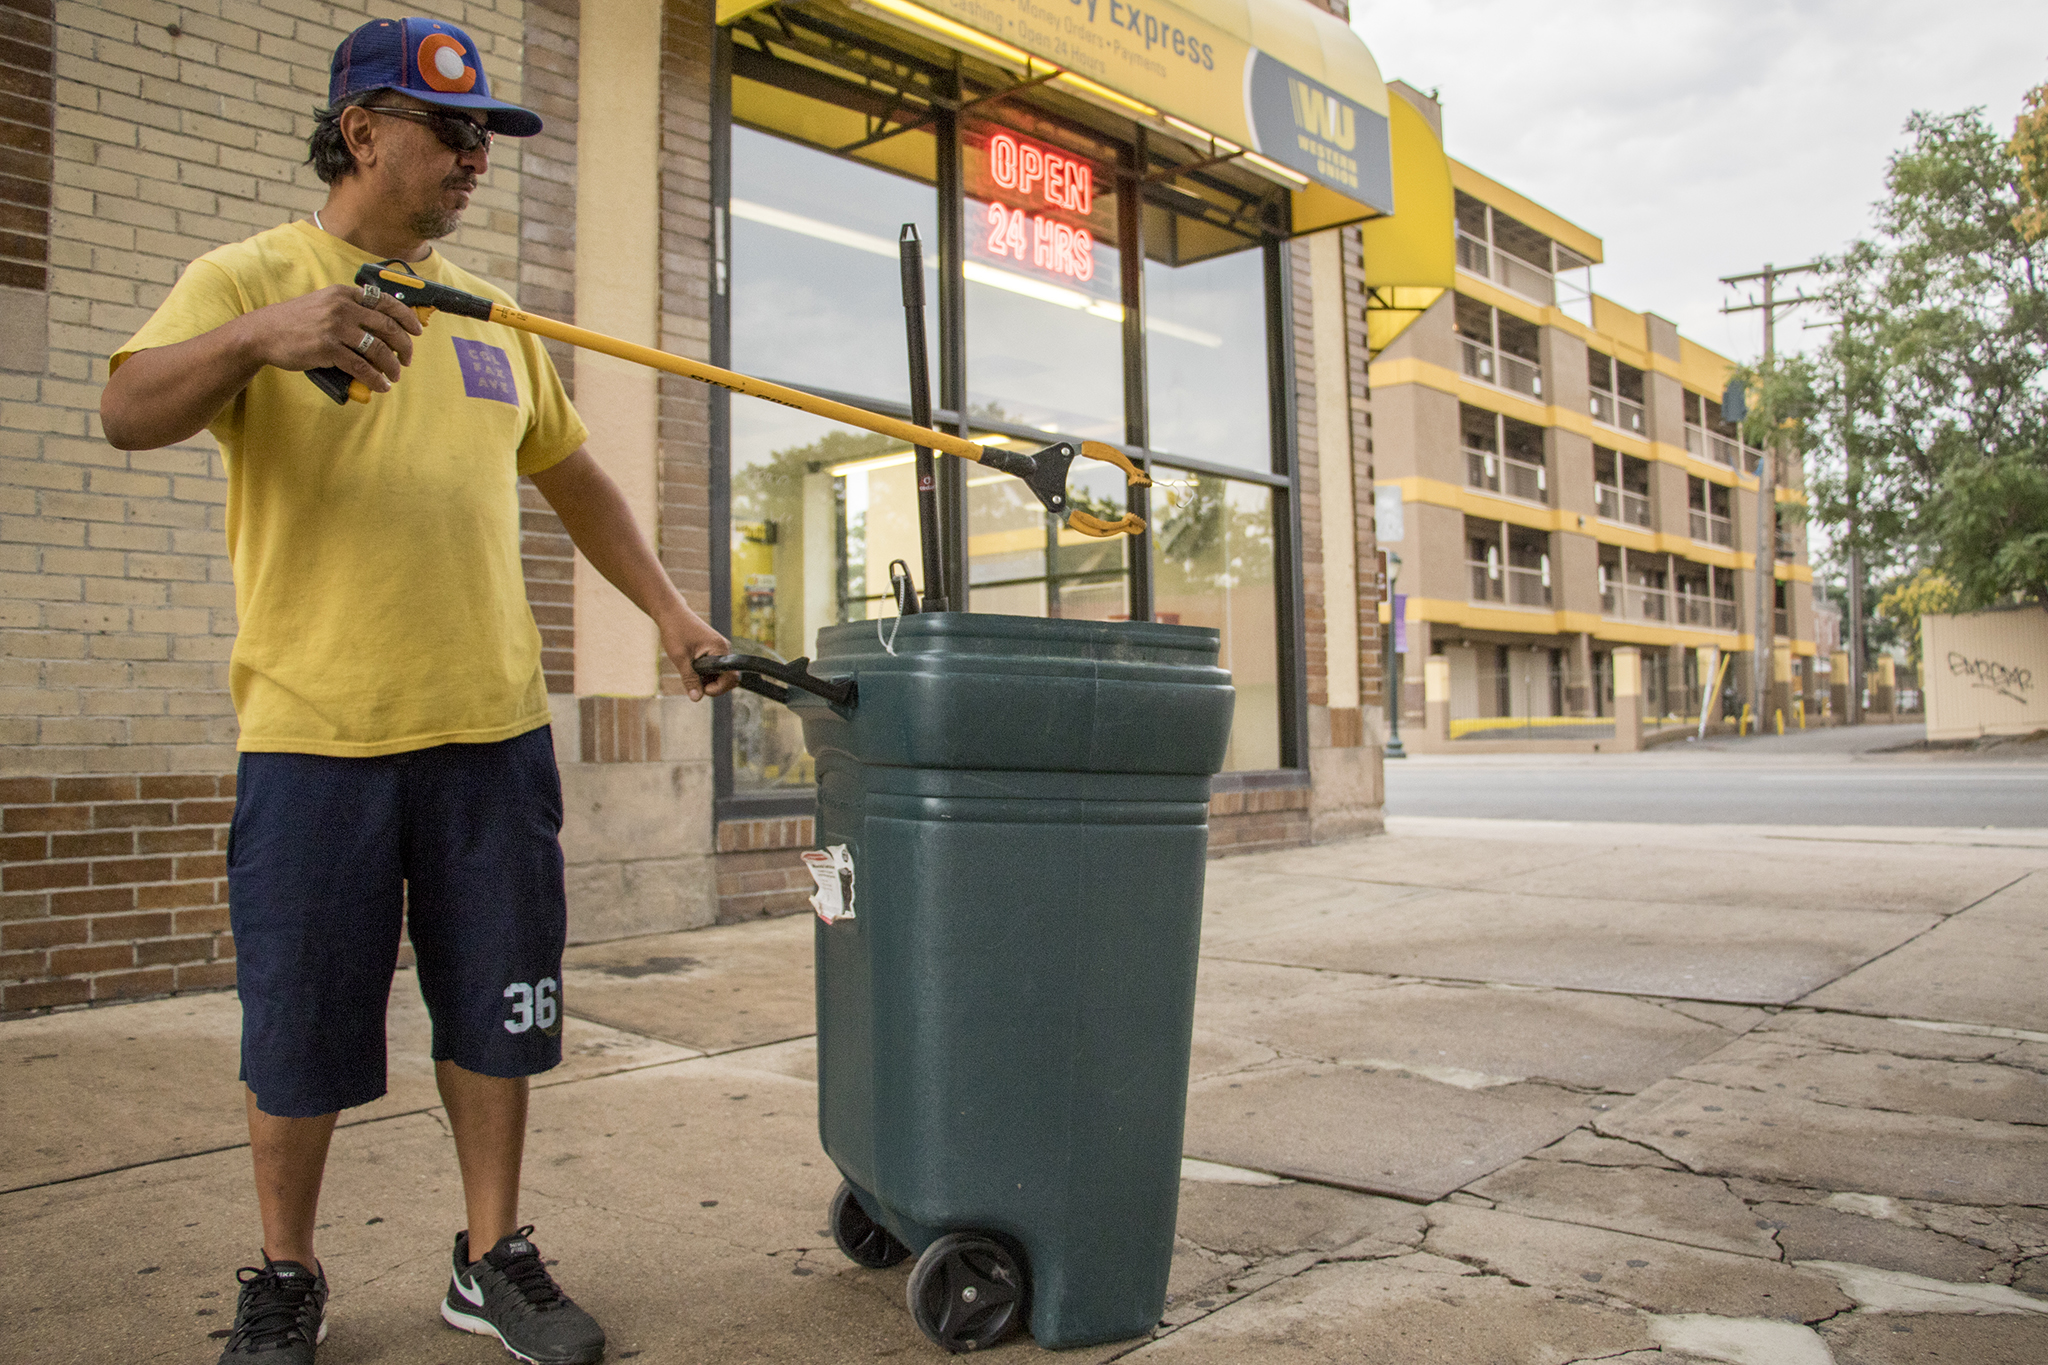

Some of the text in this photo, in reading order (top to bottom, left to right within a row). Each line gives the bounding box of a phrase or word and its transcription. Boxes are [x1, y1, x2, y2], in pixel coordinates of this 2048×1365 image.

[1018, 20, 1051, 48] Open
[1054, 36, 1069, 55] 24
[1071, 45, 1106, 74] Hours
[1064, 16, 1104, 49] Orders
[1113, 38, 1167, 79] Payments
[1110, 0, 1215, 72] Express
[990, 134, 1093, 216] OPEN
[1298, 134, 1358, 174] WESTERN
[1317, 158, 1359, 189] UNION
[987, 201, 1094, 282] 24 HRS
[503, 976, 557, 1034] 36
